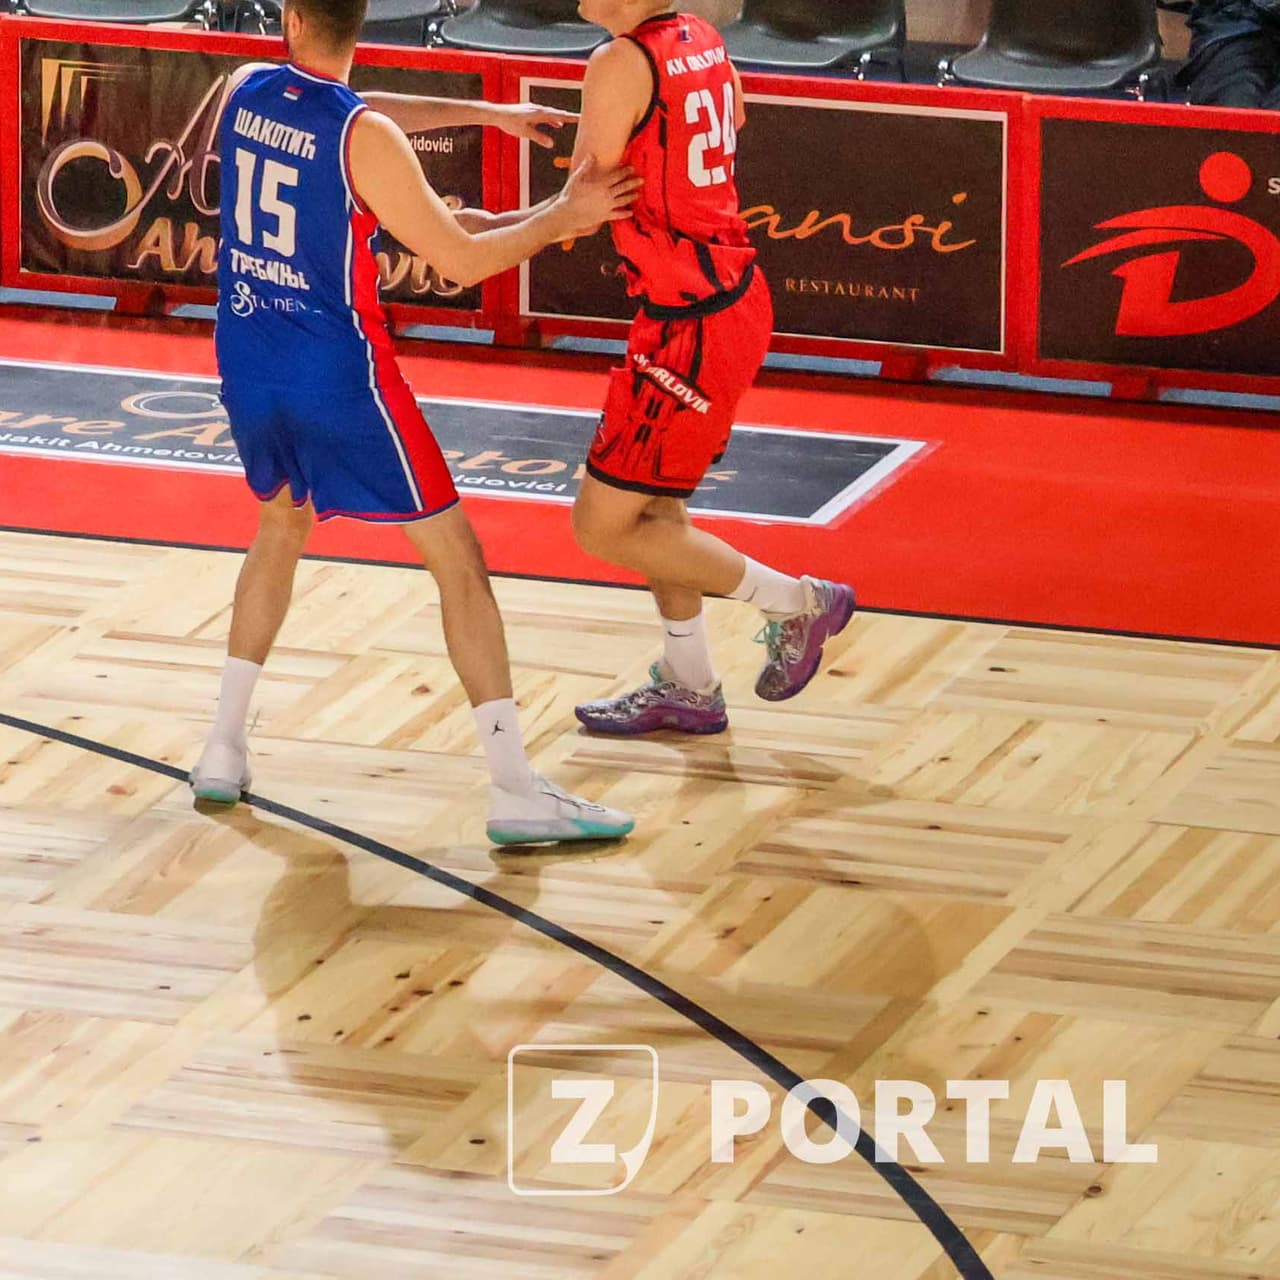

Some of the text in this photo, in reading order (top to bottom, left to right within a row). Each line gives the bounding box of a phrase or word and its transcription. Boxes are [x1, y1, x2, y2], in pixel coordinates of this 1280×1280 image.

[233, 107, 316, 160] ШАКОТИЋ
[409, 135, 454, 154] idovići
[684, 81, 737, 188] 24
[235, 147, 299, 258] 15
[738, 191, 978, 254] ansi
[784, 277, 921, 302] RESTAURANT
[452, 473, 568, 492] idovići
